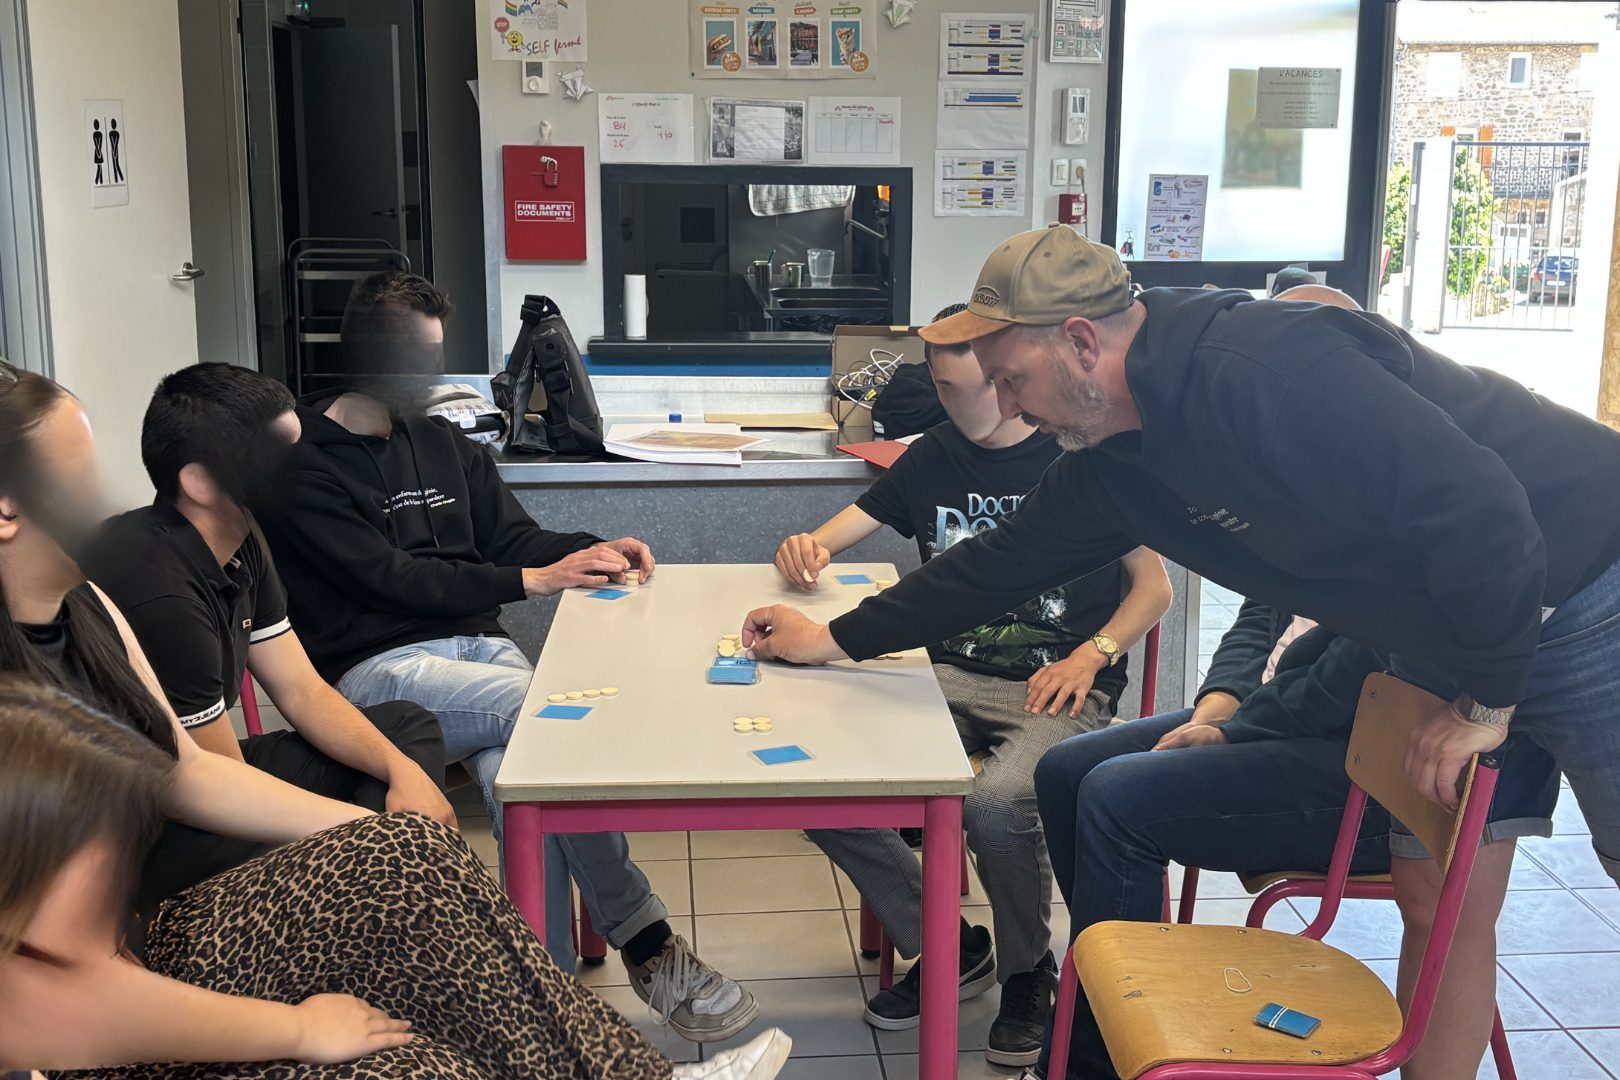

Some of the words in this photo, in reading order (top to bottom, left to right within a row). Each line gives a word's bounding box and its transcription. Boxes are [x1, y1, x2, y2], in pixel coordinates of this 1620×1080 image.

[526, 39, 550, 55] SELF
[1279, 69, 1323, 78] VACANCES
[612, 121, 626, 131] 84
